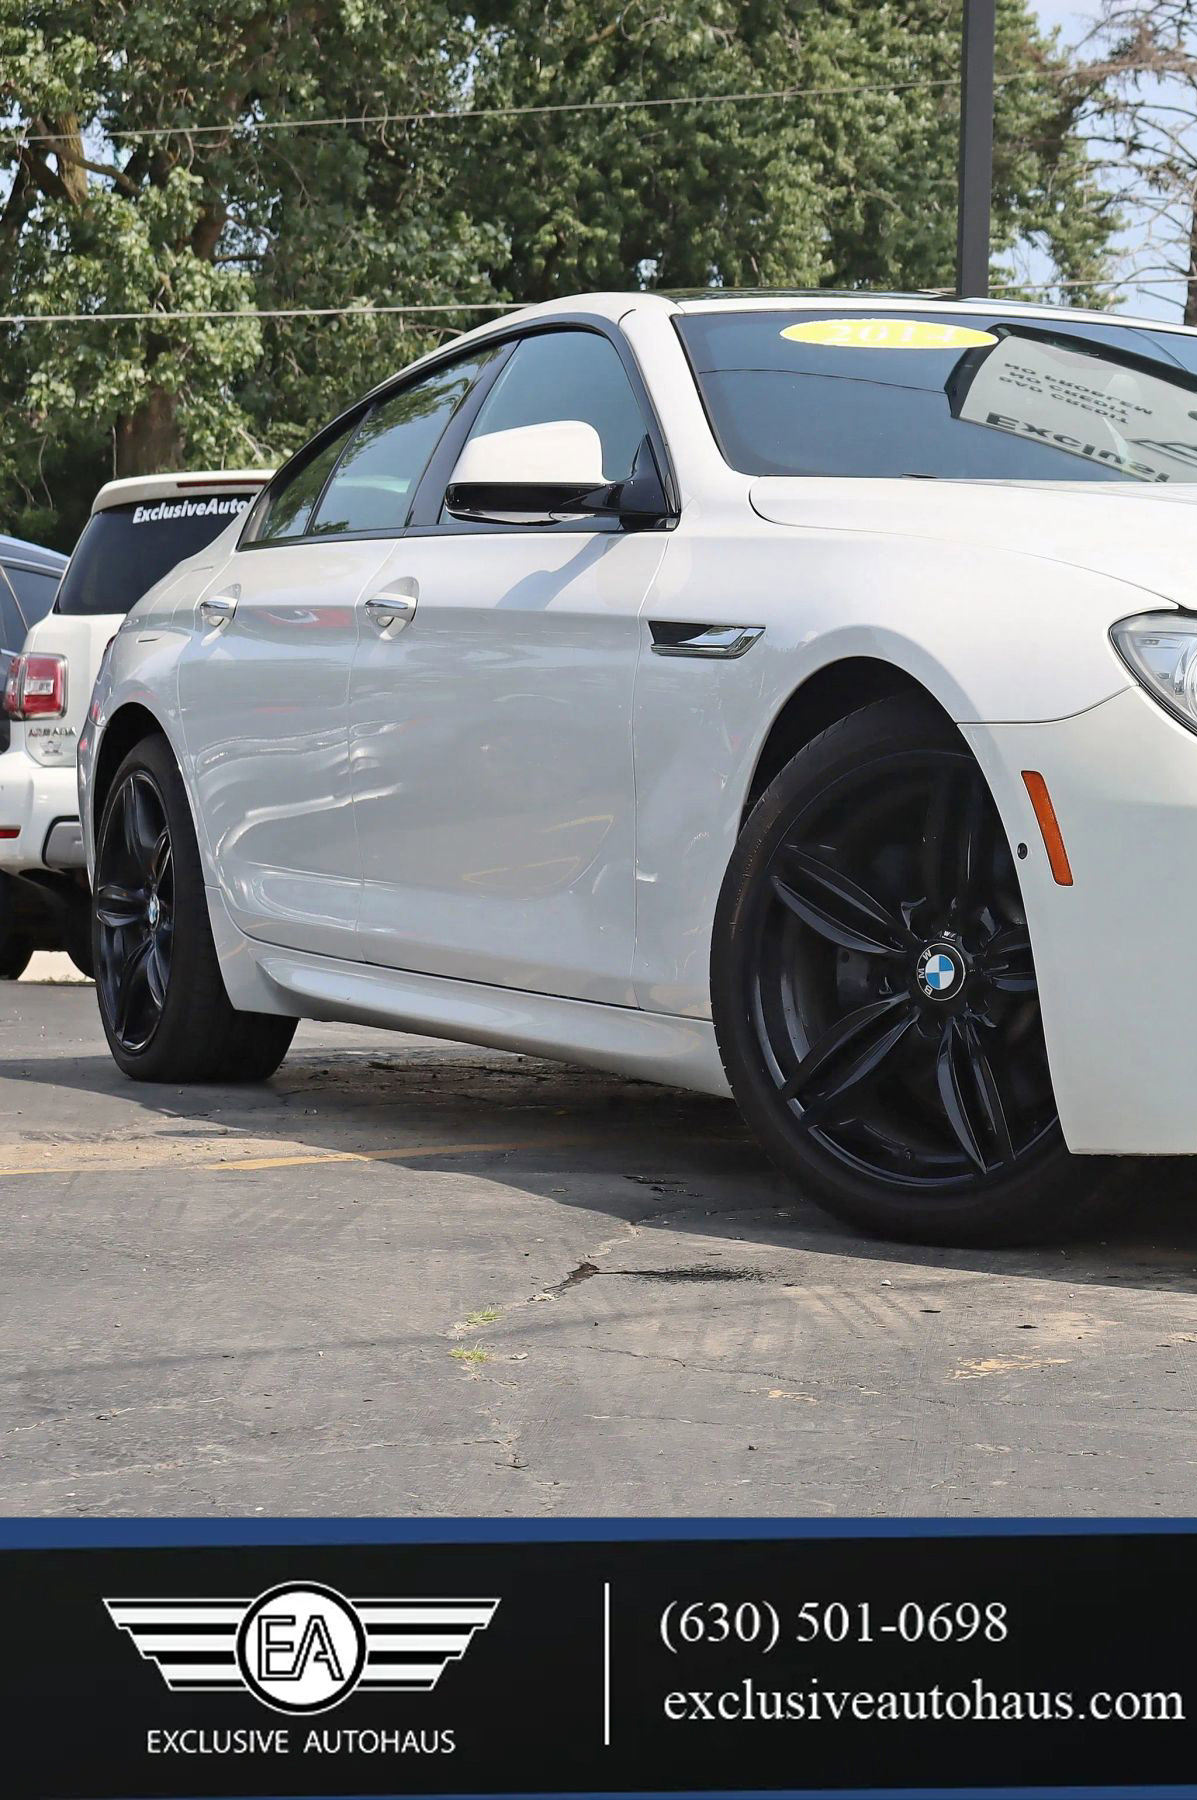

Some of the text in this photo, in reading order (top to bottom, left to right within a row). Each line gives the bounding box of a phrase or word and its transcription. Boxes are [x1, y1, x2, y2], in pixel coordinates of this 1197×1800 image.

[828, 324, 958, 344] 2014
[132, 496, 254, 524] ExclusiveAuto
[918, 949, 934, 996] BMW
